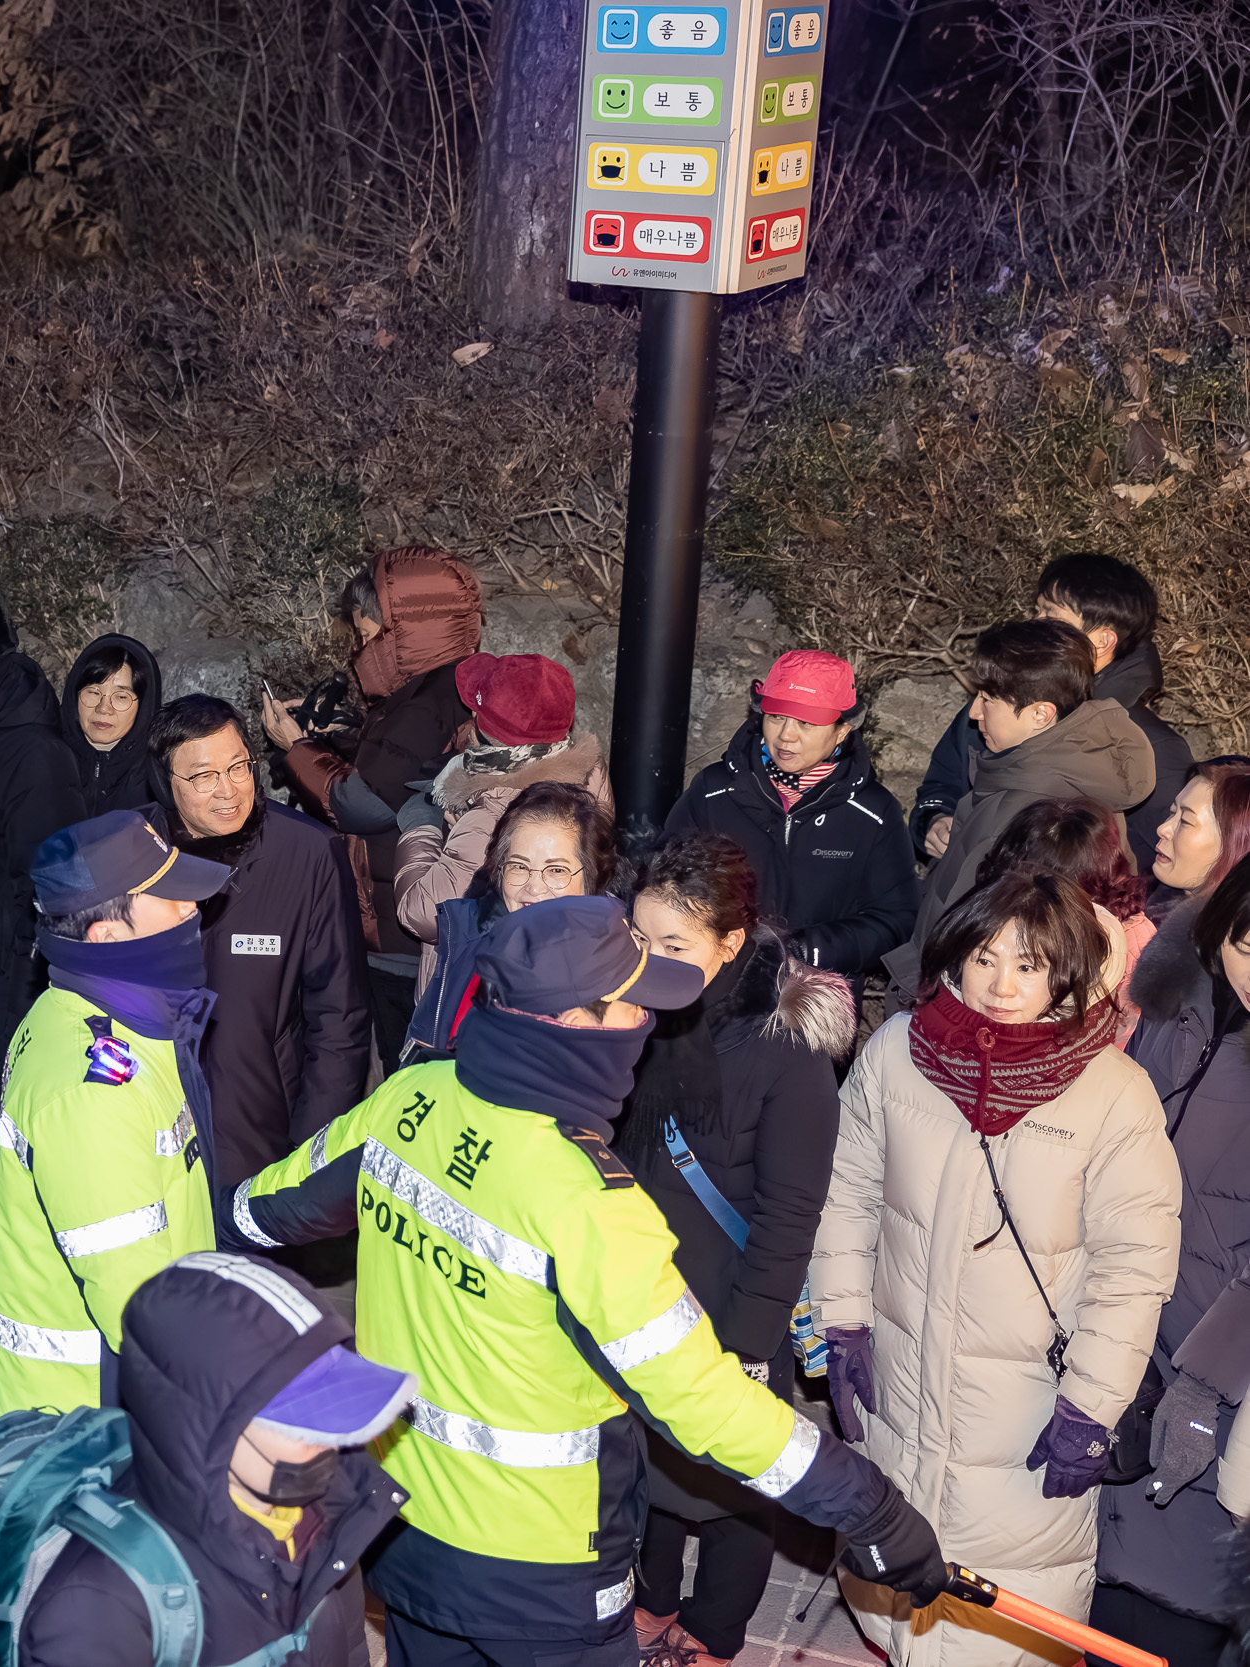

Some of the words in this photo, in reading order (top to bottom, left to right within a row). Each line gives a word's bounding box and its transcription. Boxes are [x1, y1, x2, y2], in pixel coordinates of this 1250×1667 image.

[638, 227, 698, 249] 매우나쁨
[397, 1090, 493, 1190] 경찰
[360, 1184, 486, 1300] POLICE
[868, 1544, 886, 1573] POLICE
